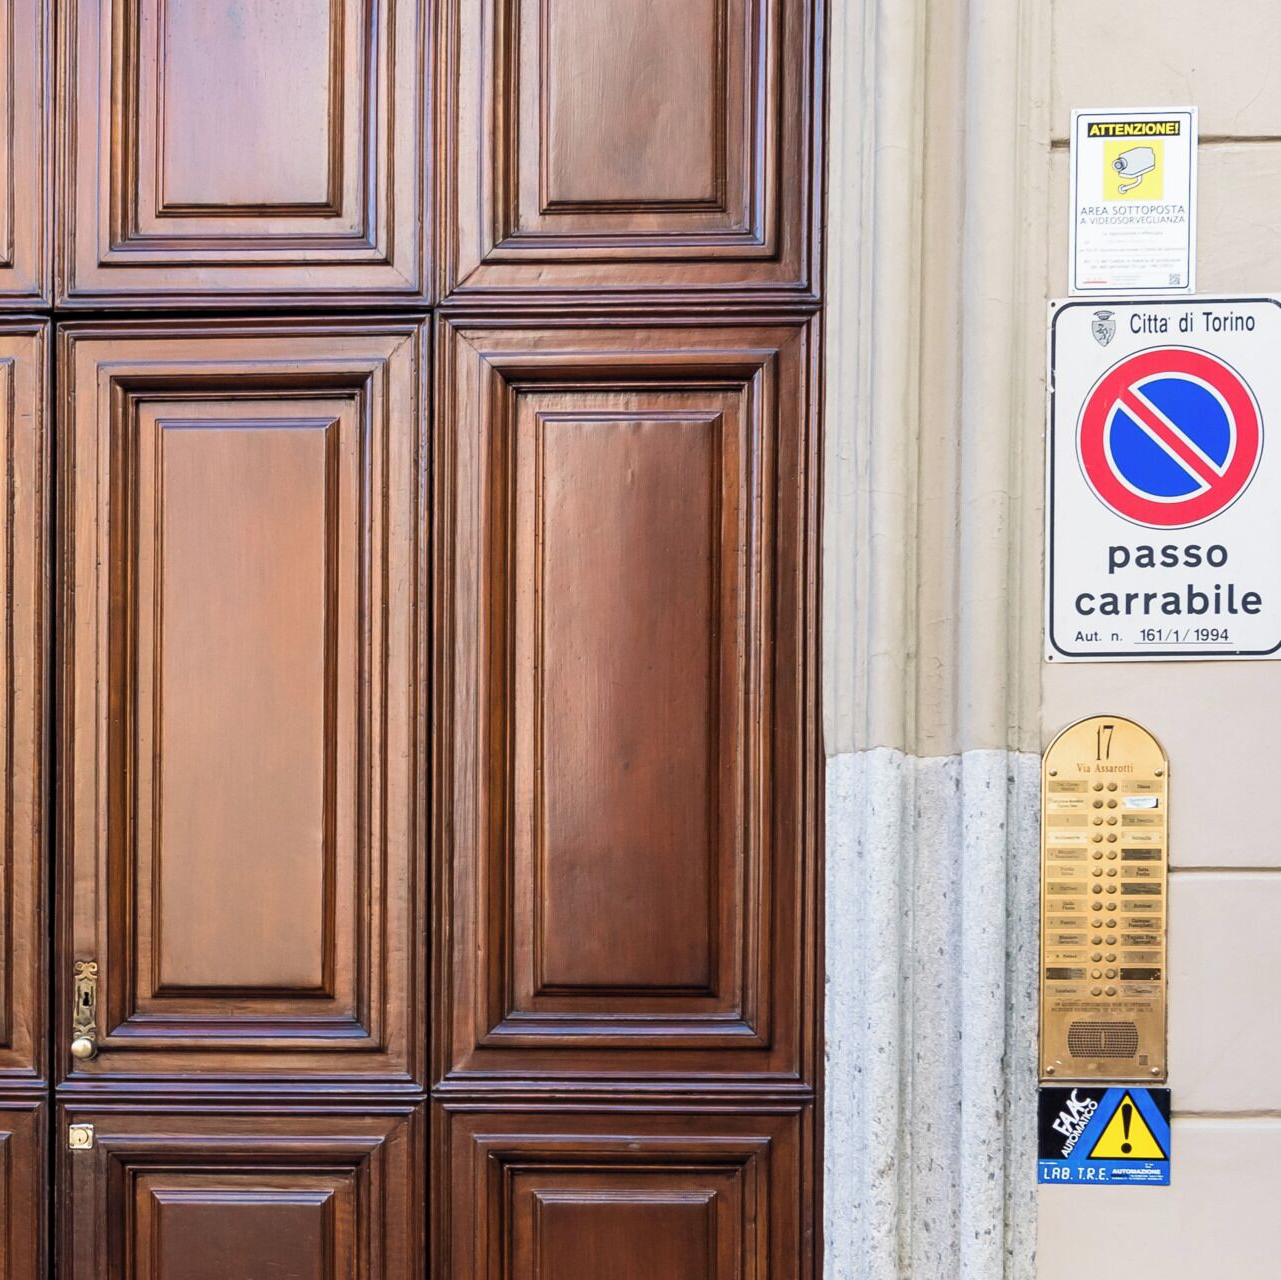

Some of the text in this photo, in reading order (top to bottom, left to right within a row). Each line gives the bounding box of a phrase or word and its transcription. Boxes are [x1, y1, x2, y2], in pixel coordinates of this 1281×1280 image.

[1089, 122, 1179, 136] ATTENZIONE!
[1080, 205, 1185, 216] AREA SOTTOPOSTA
[1080, 215, 1185, 225] A VIDEOSORVEGLIANZA
[1178, 312, 1194, 333] di
[1202, 311, 1255, 332] Torino
[1109, 544, 1228, 574] passo
[1075, 583, 1262, 615] carrabile
[1075, 631, 1102, 642] Aut.
[1111, 632, 1123, 642] n.
[1096, 725, 1115, 760] 17
[1077, 763, 1134, 773] Via Assarotti
[1052, 1088, 1091, 1136] FAAC
[1061, 1100, 1098, 1158] AUTOMATICO
[1044, 1167, 1074, 1180] LAB.
[1078, 1167, 1109, 1180] T.R.E.
